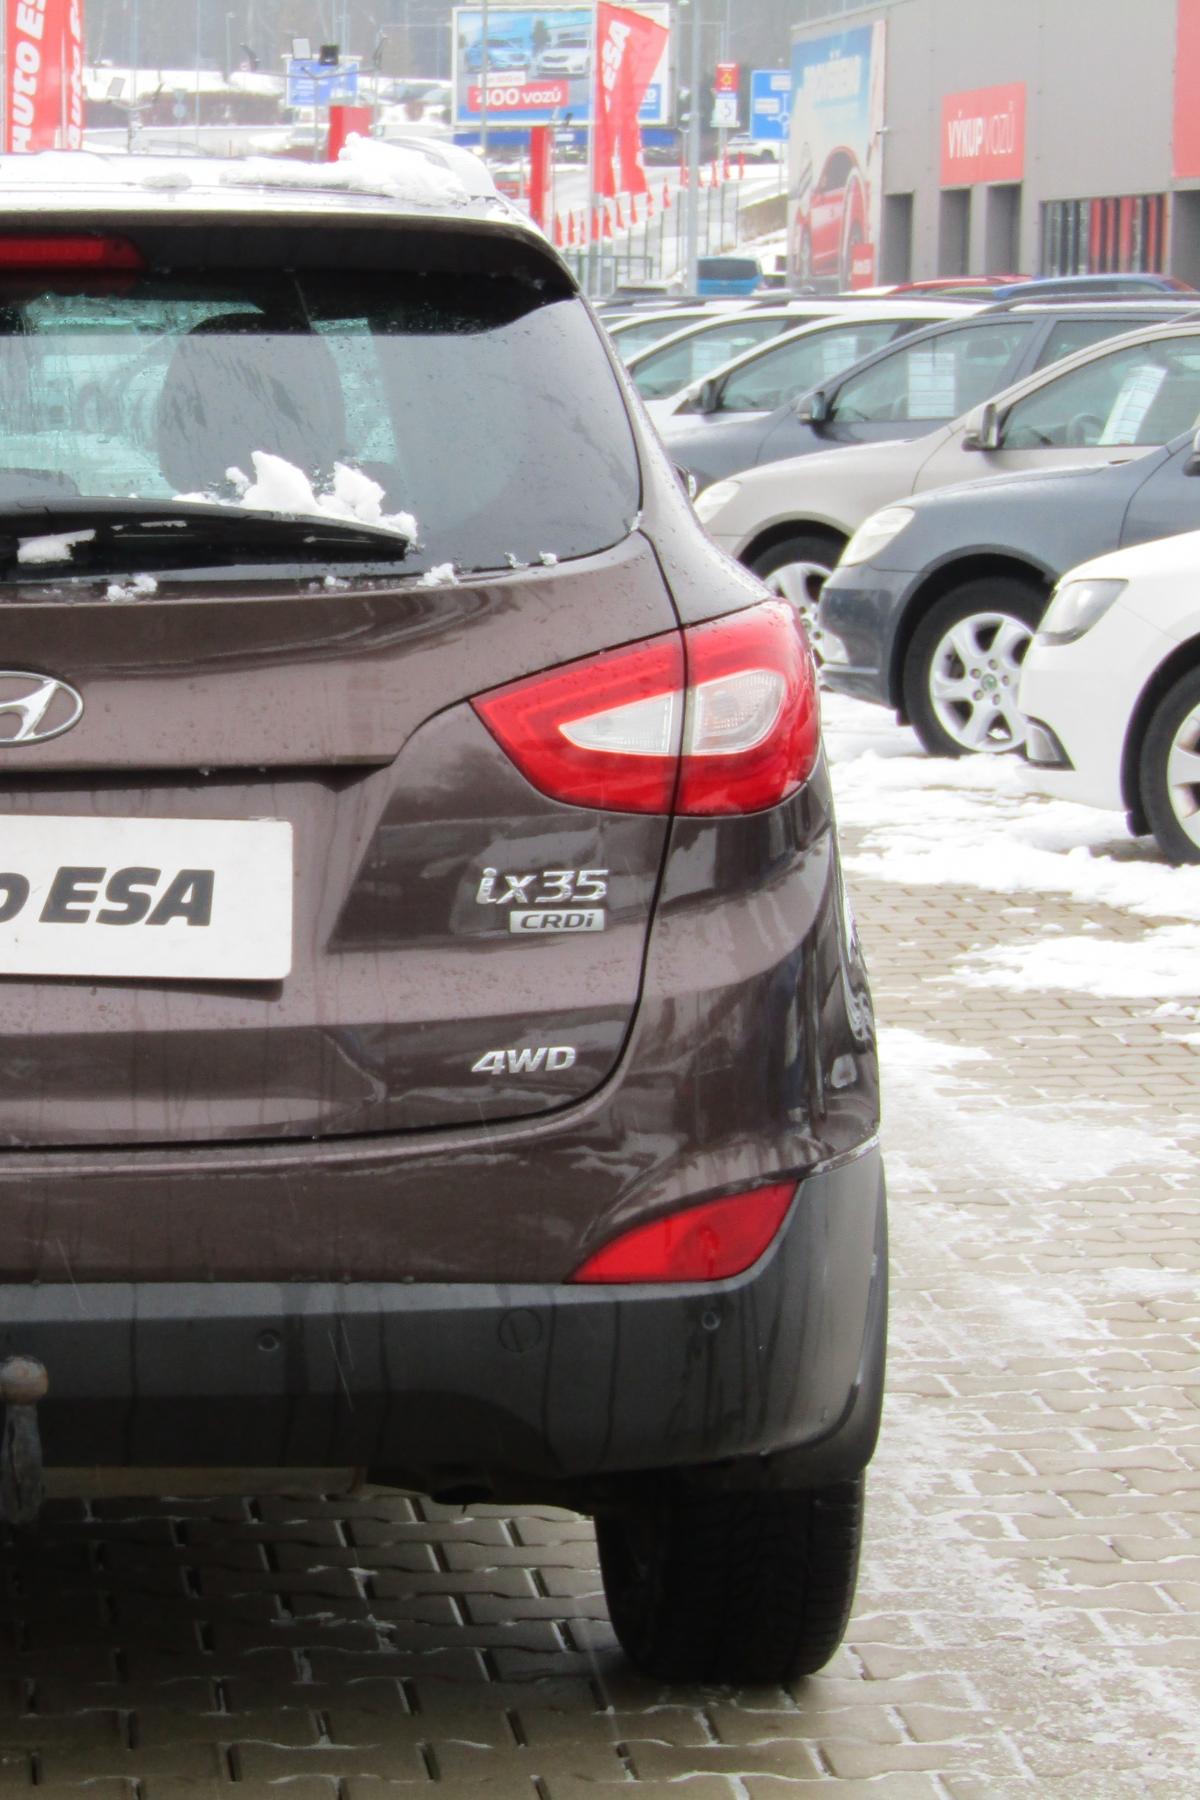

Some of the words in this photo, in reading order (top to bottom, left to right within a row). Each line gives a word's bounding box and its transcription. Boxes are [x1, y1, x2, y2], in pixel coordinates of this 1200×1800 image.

[522, 86, 563, 104] vozů
[947, 109, 984, 160] VÝKUP
[37, 866, 215, 926] ESA
[476, 867, 609, 904] ix35
[520, 913, 596, 929] CRDi
[471, 1046, 577, 1075] 4WD
